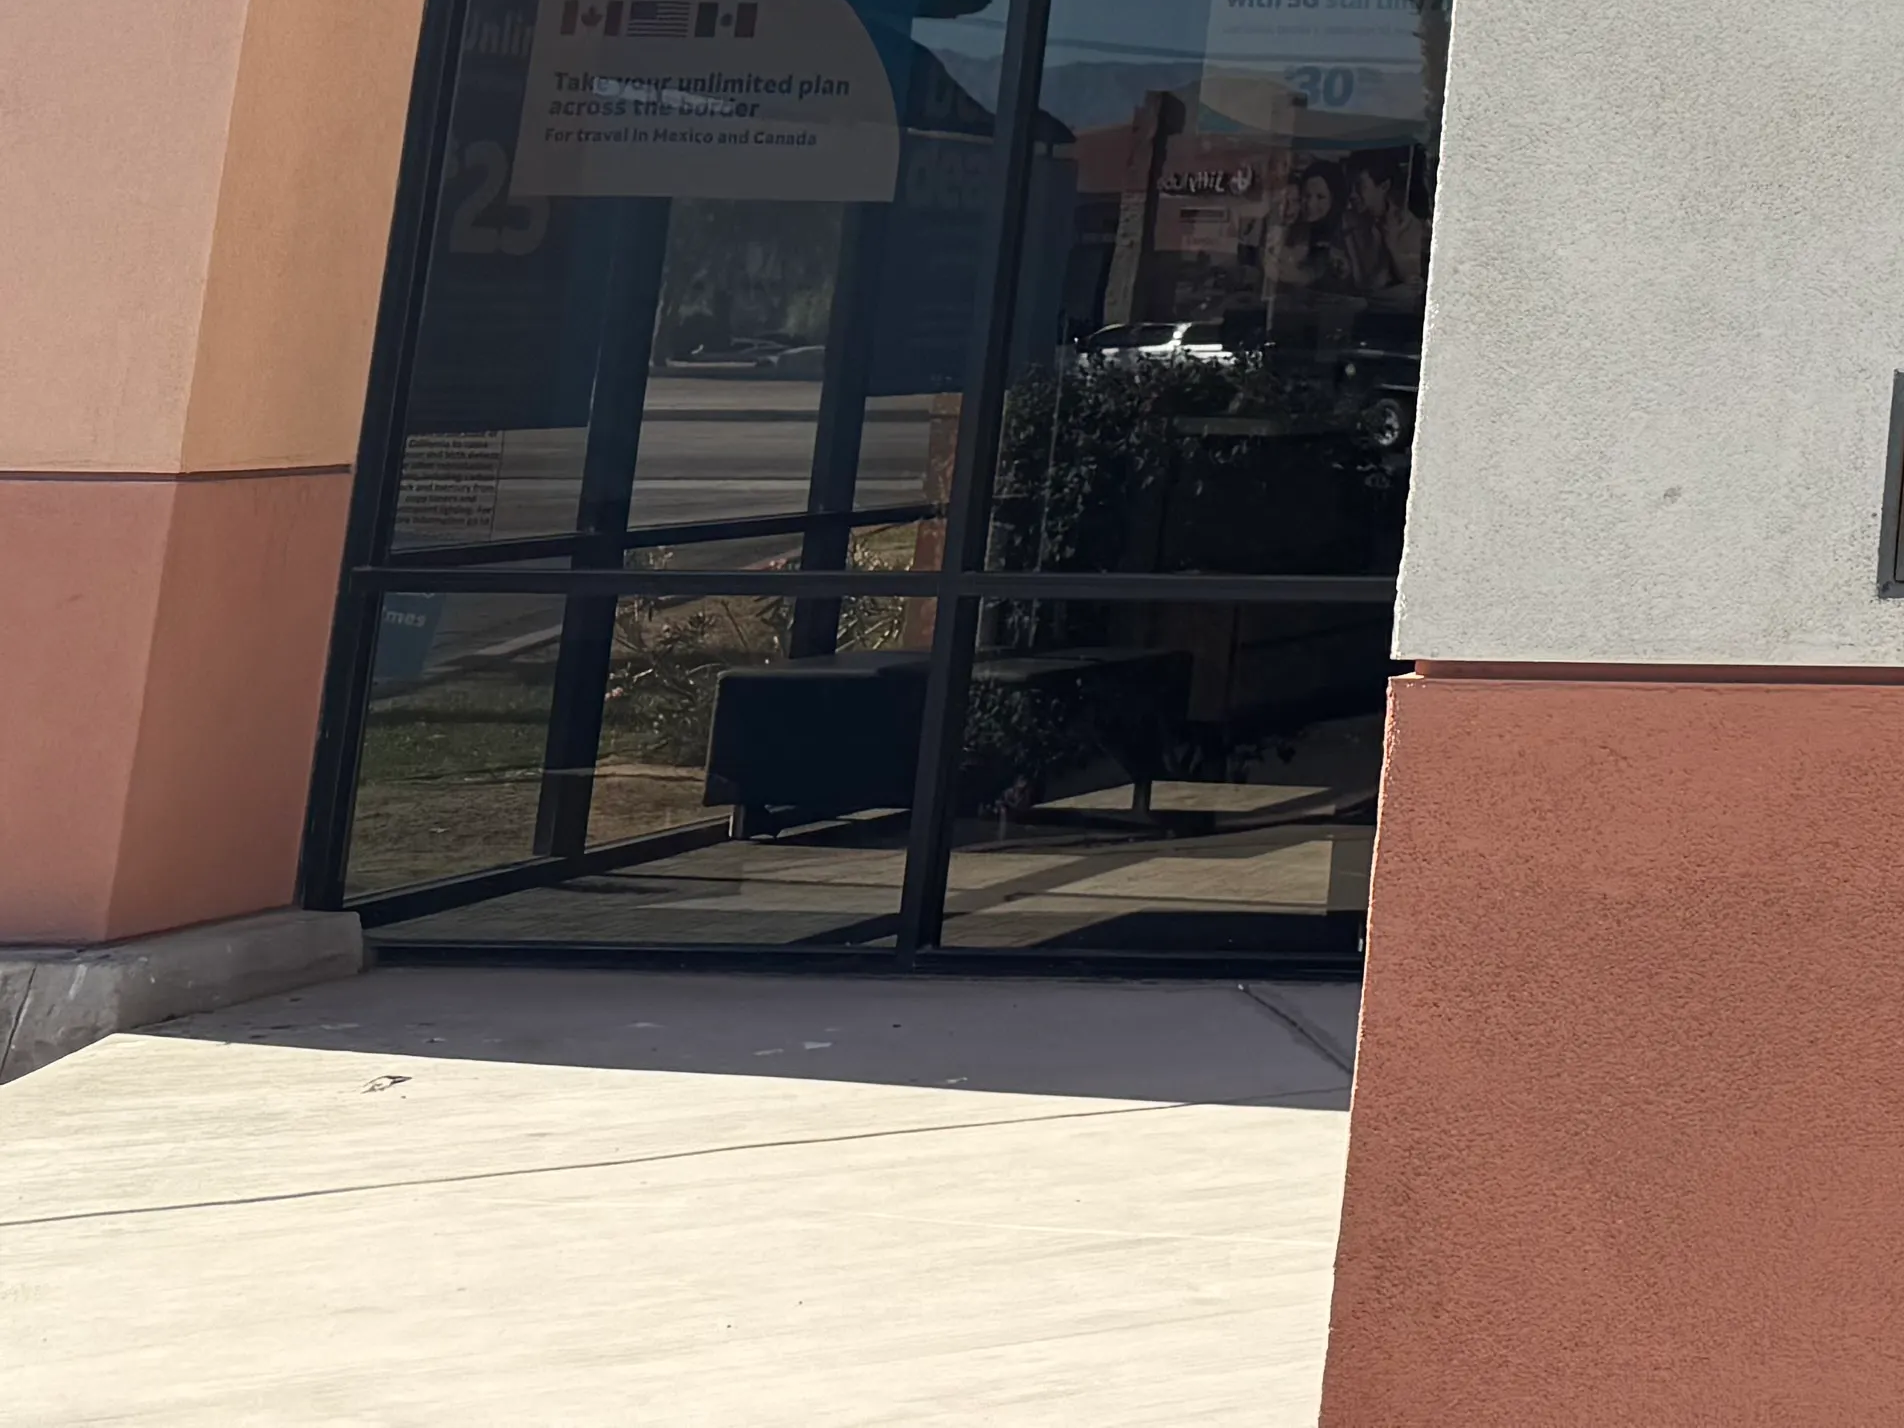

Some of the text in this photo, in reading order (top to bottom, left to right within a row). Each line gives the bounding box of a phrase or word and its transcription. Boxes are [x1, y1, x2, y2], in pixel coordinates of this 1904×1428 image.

[554, 71, 614, 96] Take
[677, 72, 793, 96] unlimited
[799, 73, 851, 101] plan
[549, 98, 759, 118] across the border
[545, 128, 573, 143] For
[576, 128, 628, 143] travel
[653, 129, 714, 145] Mexico
[718, 130, 749, 146] and
[754, 131, 817, 147] Canada
